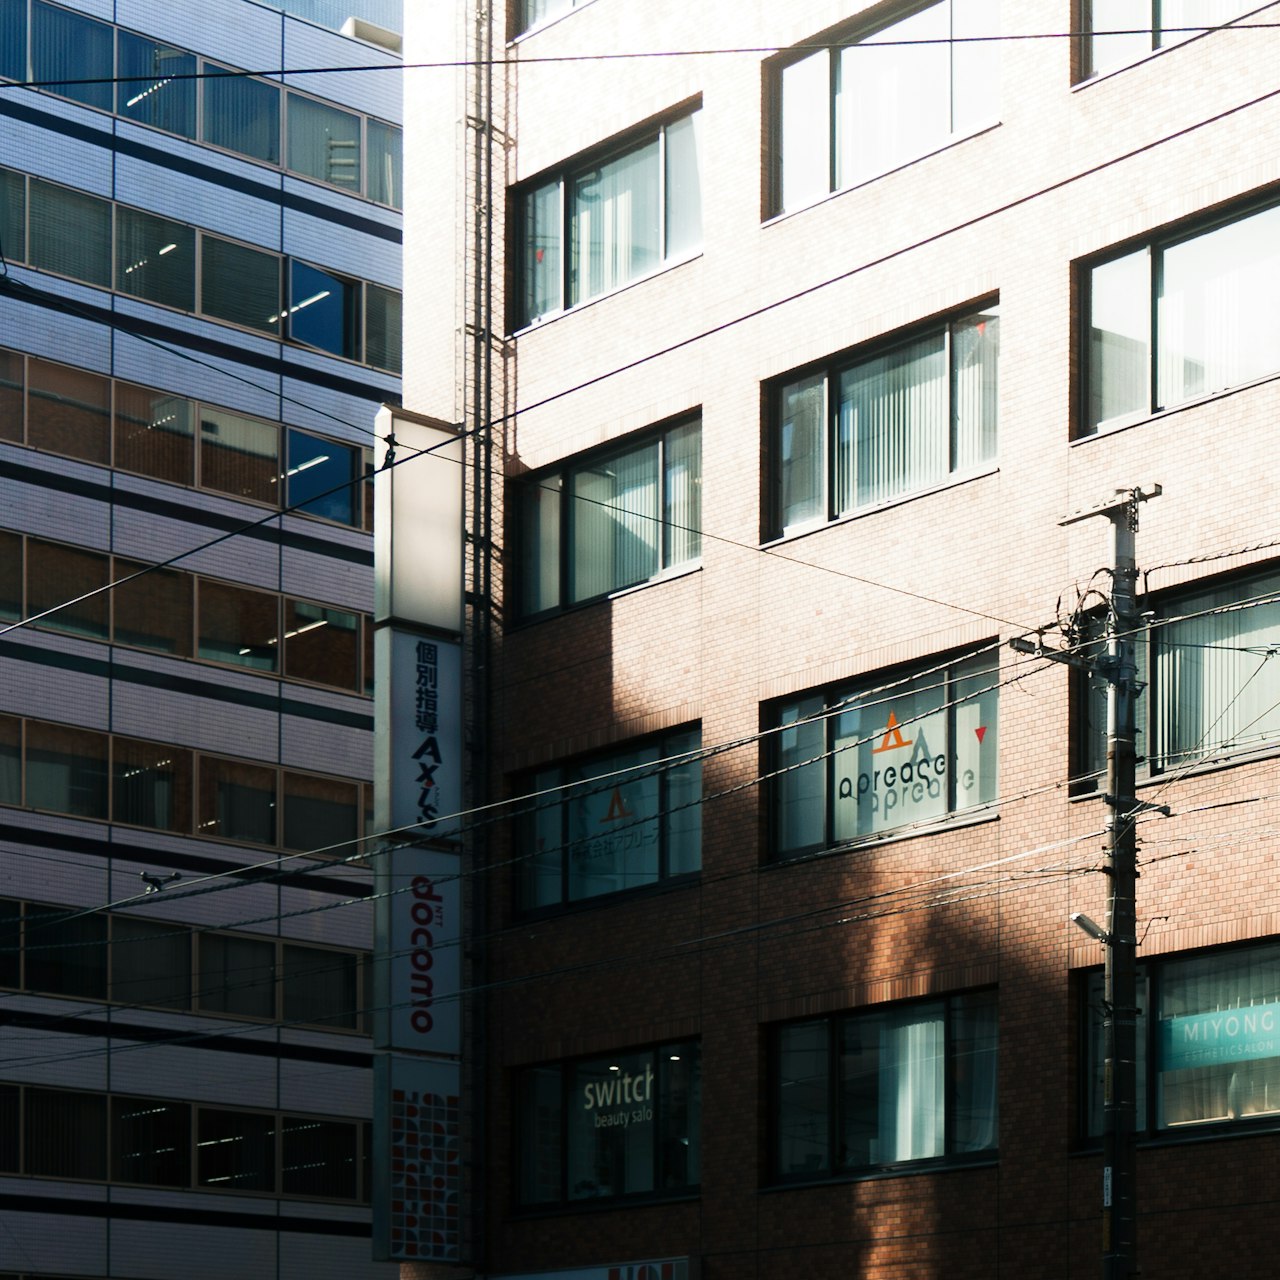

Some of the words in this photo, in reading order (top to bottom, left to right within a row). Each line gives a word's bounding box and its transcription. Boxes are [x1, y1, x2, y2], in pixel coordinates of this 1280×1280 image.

[410, 876, 443, 1034] docomo
[1184, 1011, 1274, 1043] MIYONG
[594, 1111, 630, 1129] beauty
